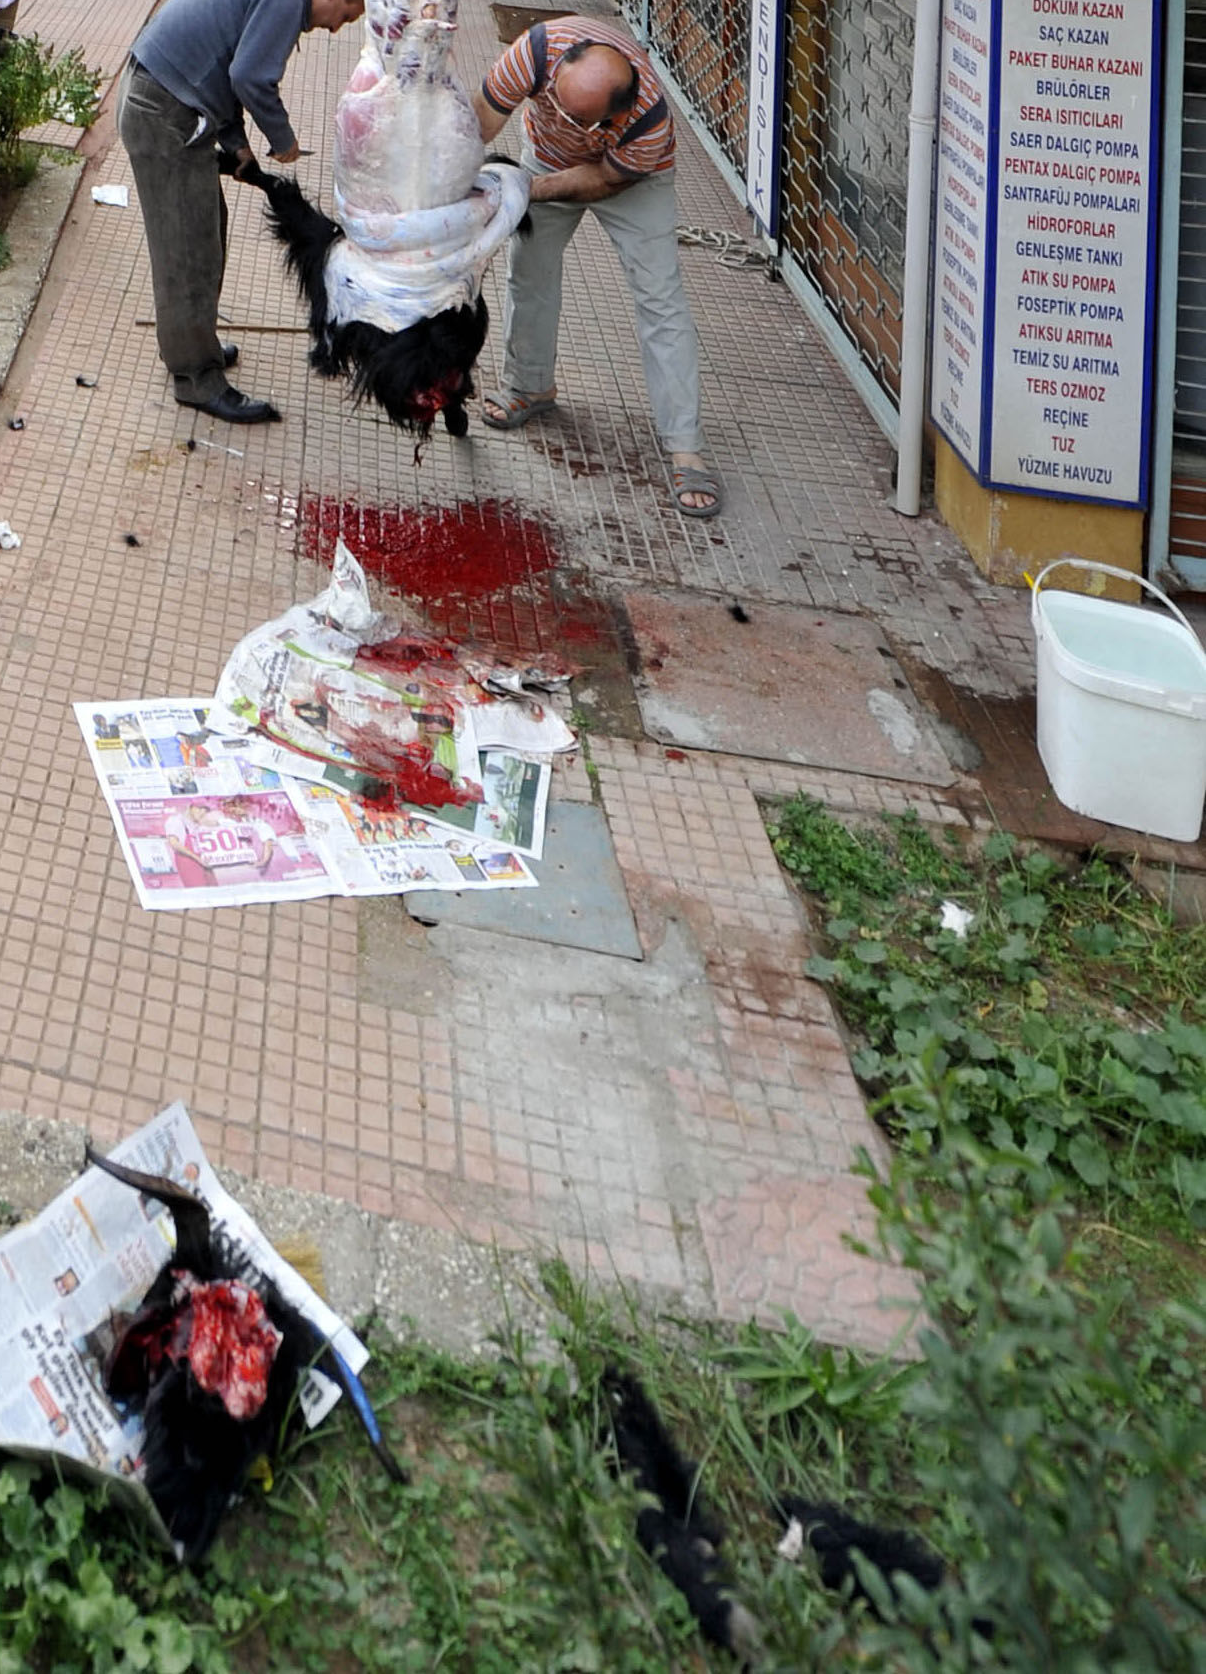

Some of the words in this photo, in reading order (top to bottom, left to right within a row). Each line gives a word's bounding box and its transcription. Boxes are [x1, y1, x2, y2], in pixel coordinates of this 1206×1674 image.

[1082, 2, 1124, 20] KAZAN
[1039, 25, 1064, 47] SAÇ
[1067, 28, 1109, 46] KAZAN
[1009, 50, 1048, 68] PAKET
[1051, 54, 1094, 72] BUHAR
[1098, 58, 1143, 77] KAZANI
[1036, 77, 1110, 101] BRÜLÖRLER
[1020, 105, 1052, 123] SERA
[1010, 131, 1042, 149] SAER
[1046, 135, 1092, 159] DALGIÇ
[1095, 140, 1139, 159] POMPA
[1005, 157, 1049, 177] PENTAX
[1052, 162, 1096, 186] DALGIÇ
[1099, 167, 1141, 186] POMPA
[1004, 184, 1070, 206] SANTRAFÜJ
[1073, 191, 1140, 214] POMPALARI
[1027, 211, 1116, 239] HİDROFORLAR
[1016, 240, 1083, 265] GENLEŞME
[1086, 248, 1123, 267] TANKI
[1021, 269, 1049, 287] ATIK
[1052, 272, 1069, 289] SU
[1072, 274, 1116, 294] POMPA
[1017, 295, 1077, 317] FOSEPTİK
[1080, 302, 1124, 322] POMPA
[1018, 323, 1063, 343] ATIKSU
[1066, 329, 1113, 349] ARITMA
[1012, 348, 1050, 368] TEMİZ
[1052, 353, 1069, 370] SU
[1072, 356, 1120, 377] ARITMA
[1026, 377, 1057, 396] TERS
[1061, 382, 1106, 402] OZMOZ
[1043, 407, 1089, 429] REÇİNE
[1051, 436, 1075, 453] TUZ
[1018, 454, 1060, 478] YÜZME
[1063, 464, 1112, 485] HAVUZU
